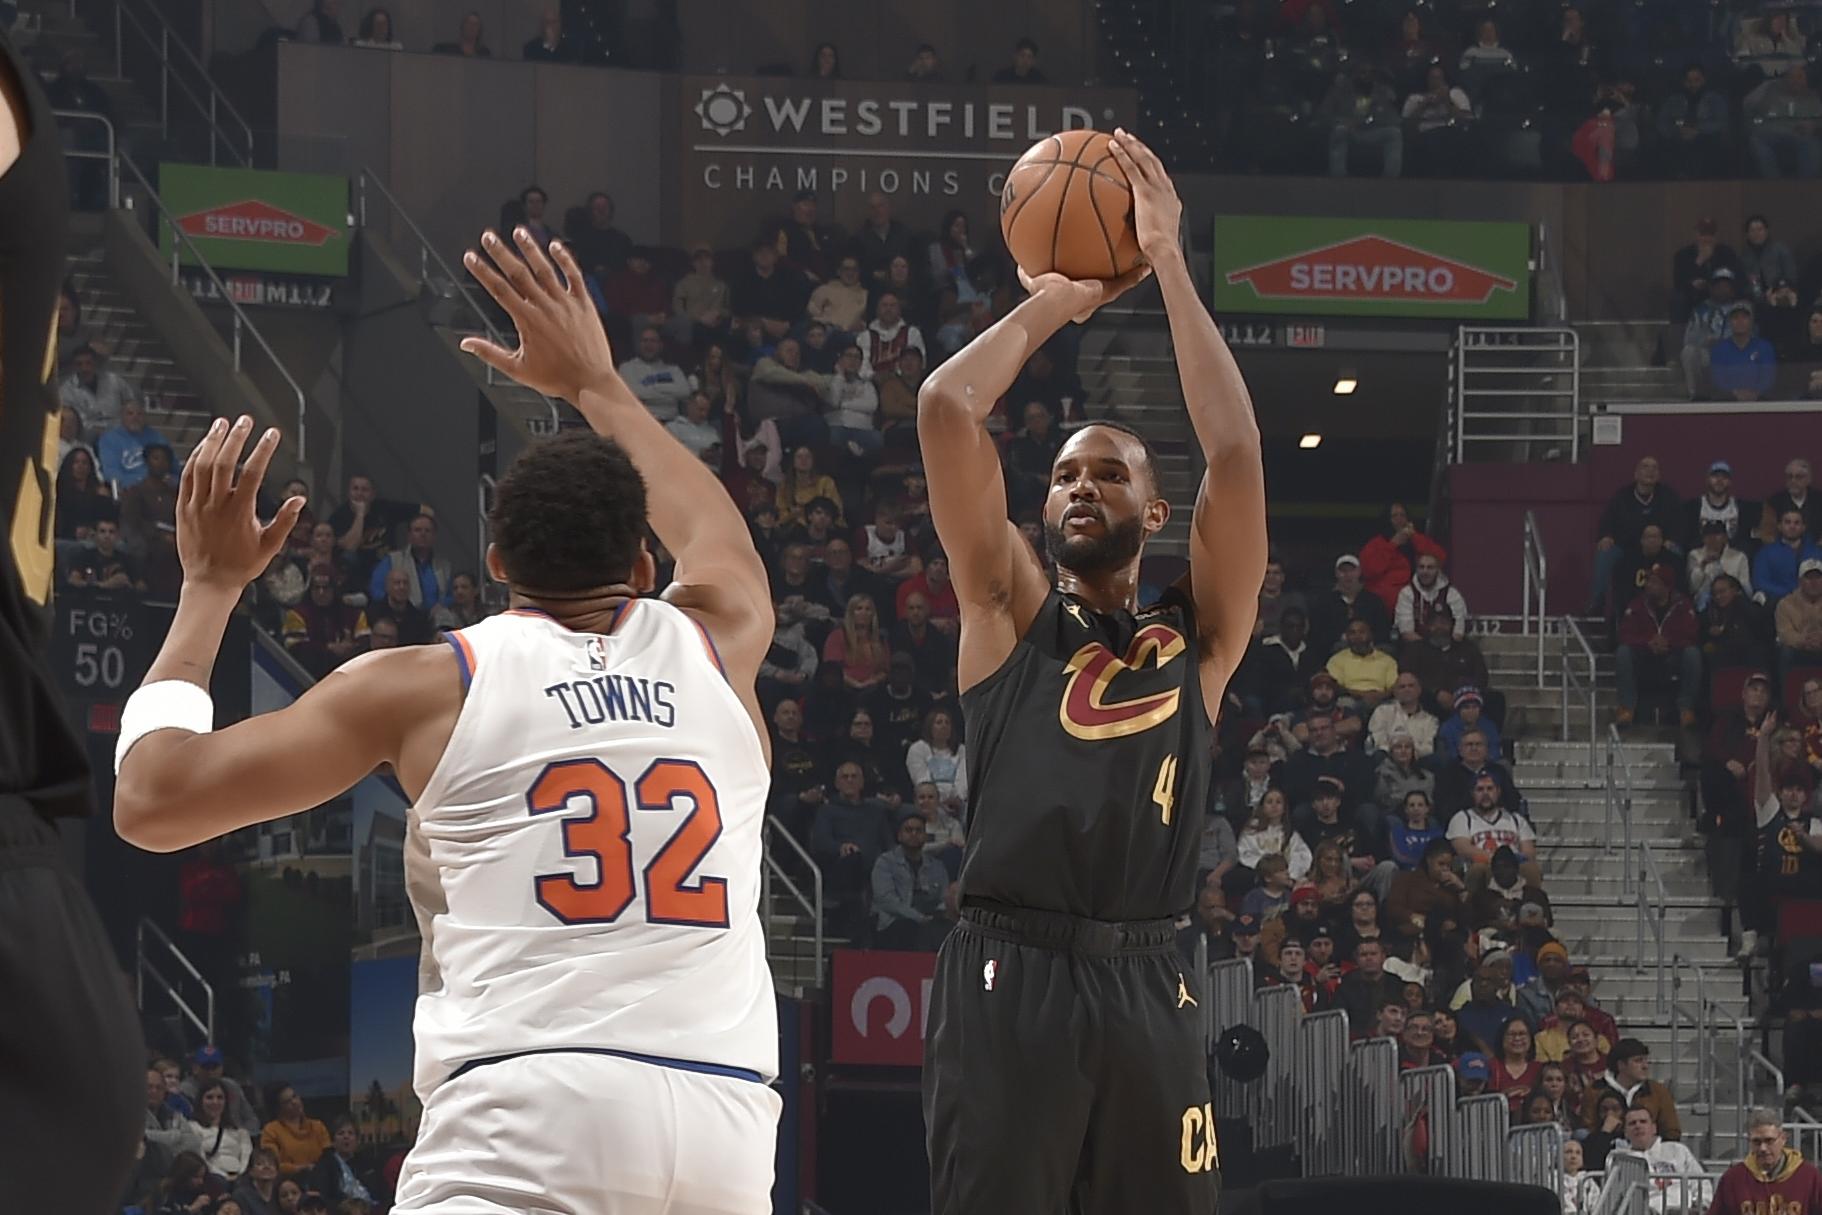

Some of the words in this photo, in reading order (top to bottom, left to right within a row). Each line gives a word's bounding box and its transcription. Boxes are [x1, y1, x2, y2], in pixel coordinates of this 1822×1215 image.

[763, 97, 1093, 141] WESTFIELD
[703, 165, 960, 196] CHAMPIONS
[205, 215, 304, 239] SERVPRO
[1290, 263, 1454, 294] SERVPRO
[70, 609, 134, 640] FG%
[75, 643, 124, 688] 50
[544, 674, 675, 729] TOWNS
[1153, 753, 1178, 826] 4
[526, 757, 731, 929] 32
